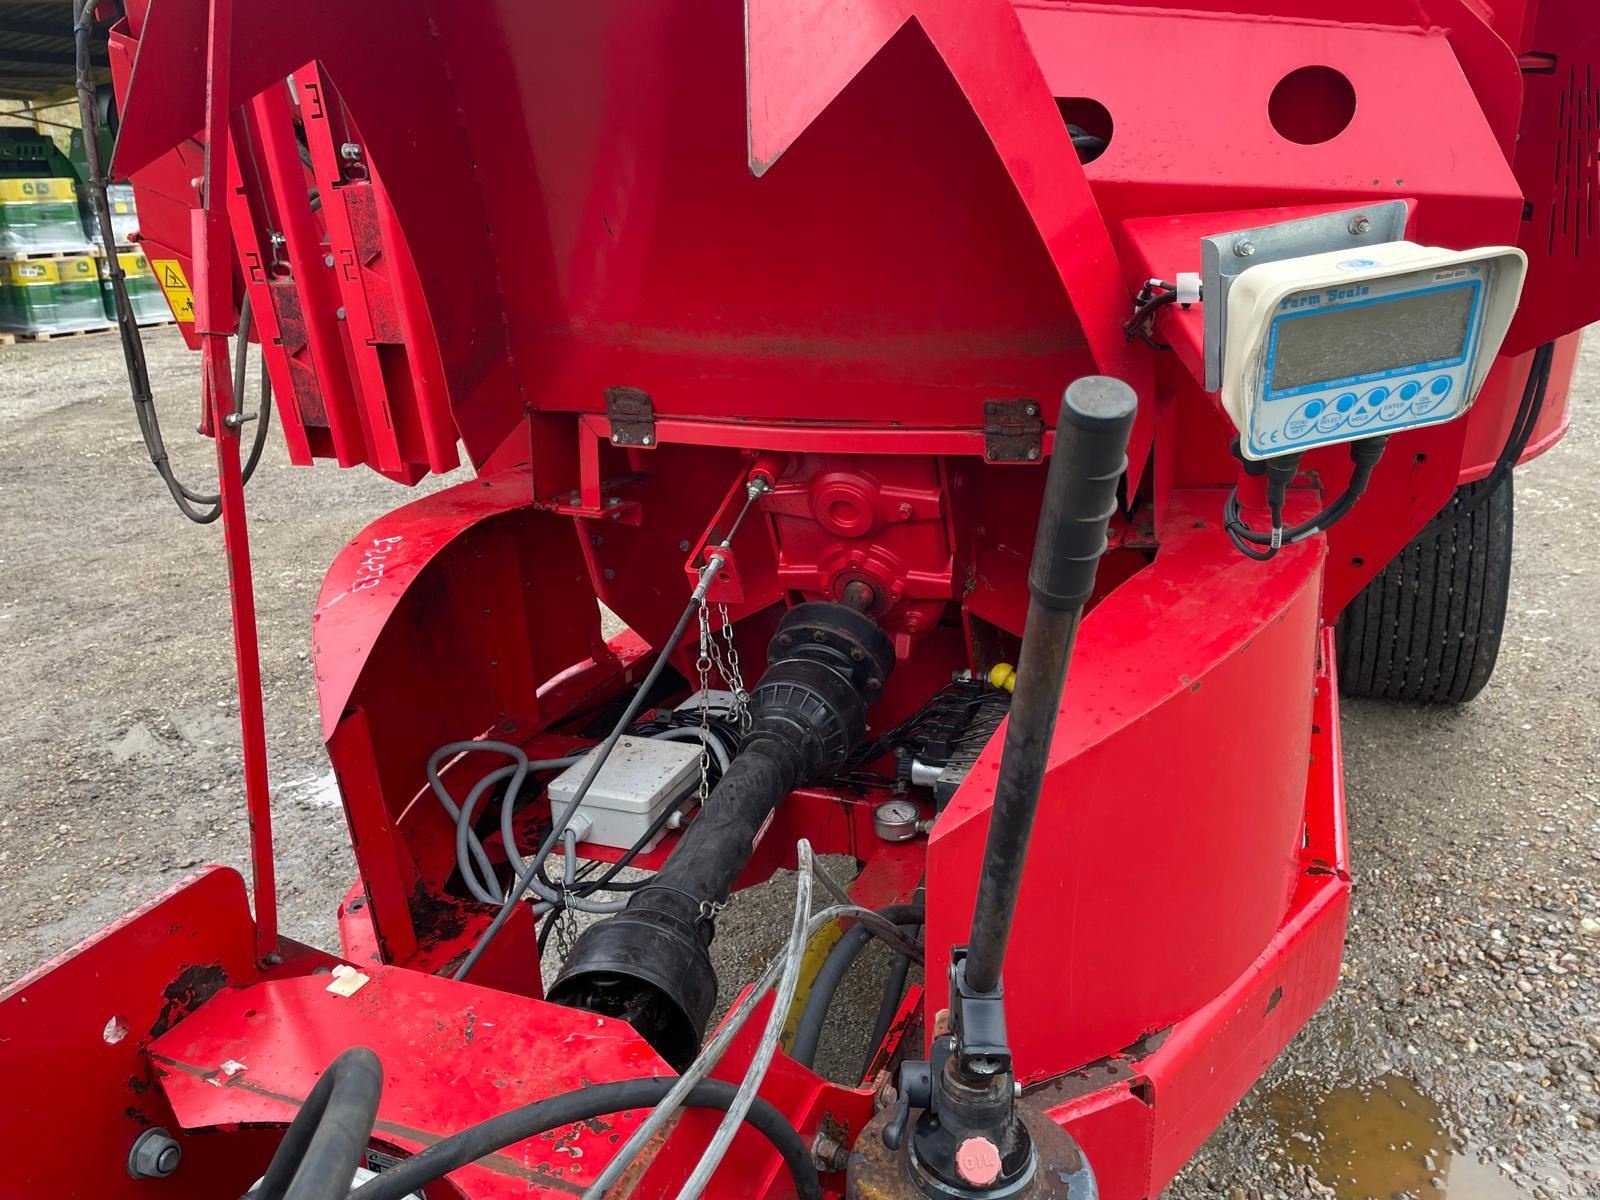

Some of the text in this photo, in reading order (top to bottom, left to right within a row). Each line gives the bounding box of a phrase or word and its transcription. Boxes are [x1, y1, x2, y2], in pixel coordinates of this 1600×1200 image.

[1326, 285, 1369, 302] Scale
[1383, 401, 1406, 411] ENTER
[1351, 414, 1369, 422] HOLD
[964, 1152, 995, 1171] OIL
